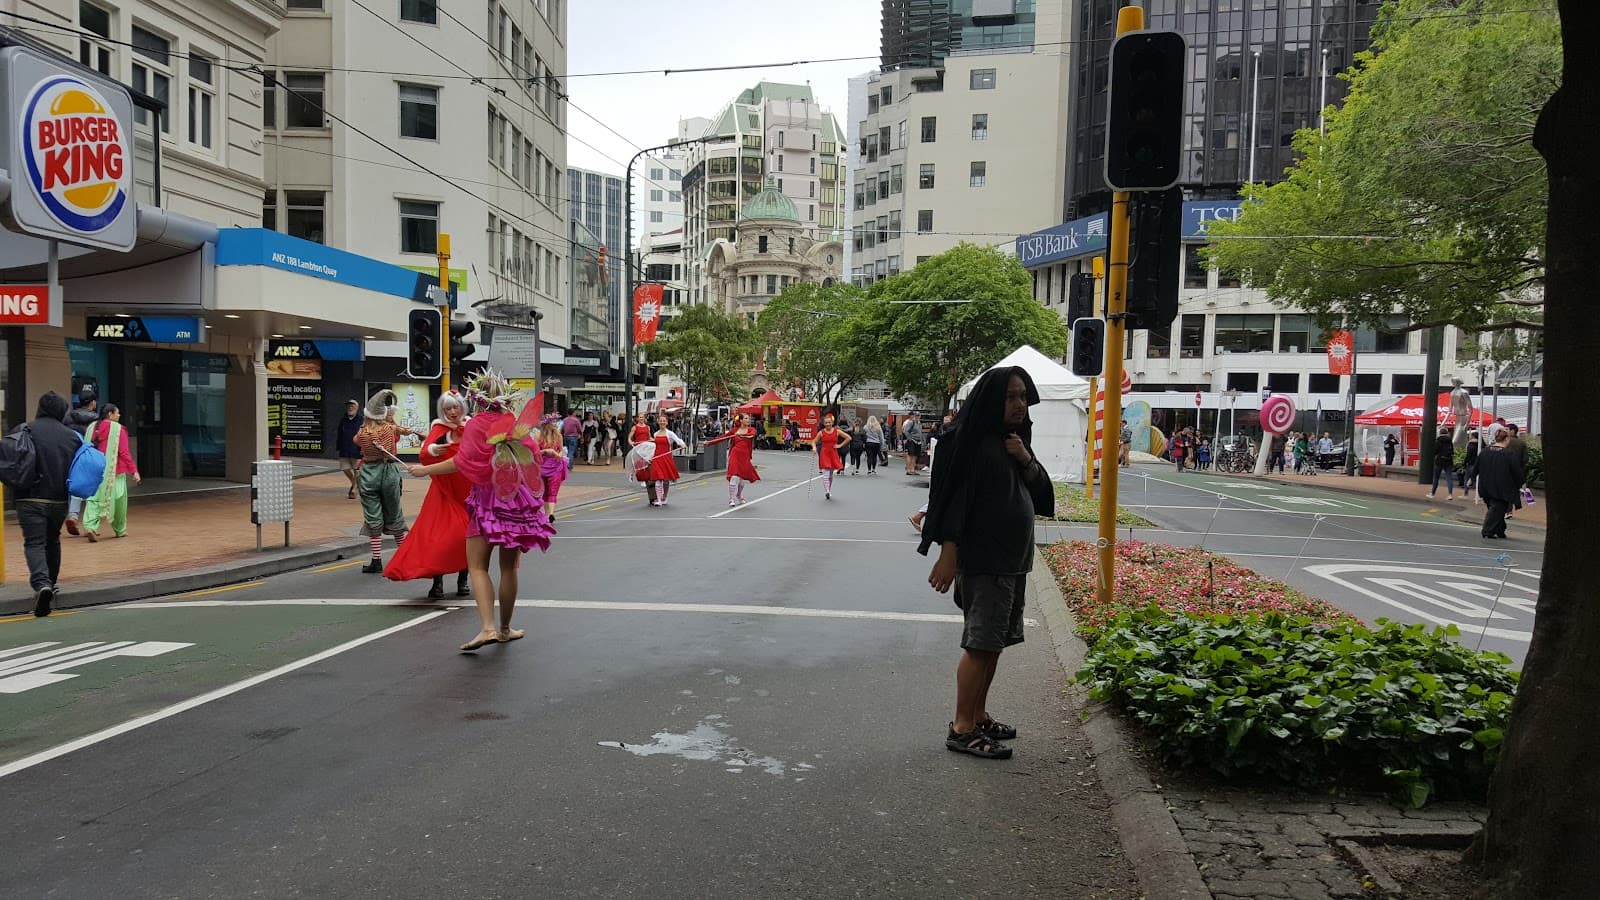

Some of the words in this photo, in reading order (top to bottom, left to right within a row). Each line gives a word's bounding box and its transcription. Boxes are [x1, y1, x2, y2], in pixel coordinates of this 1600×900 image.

[38, 117, 119, 149] BURGER
[43, 144, 123, 190] KING
[1019, 236, 1043, 262] TSB
[1045, 227, 1079, 256] Bank
[272, 252, 286, 264] ANZ
[298, 258, 322, 273] Lambton
[322, 264, 337, 278] Quay
[93, 324, 124, 337] ANZ
[275, 346, 299, 356] ANZ
[273, 384, 292, 392] office
[293, 384, 321, 393] location
